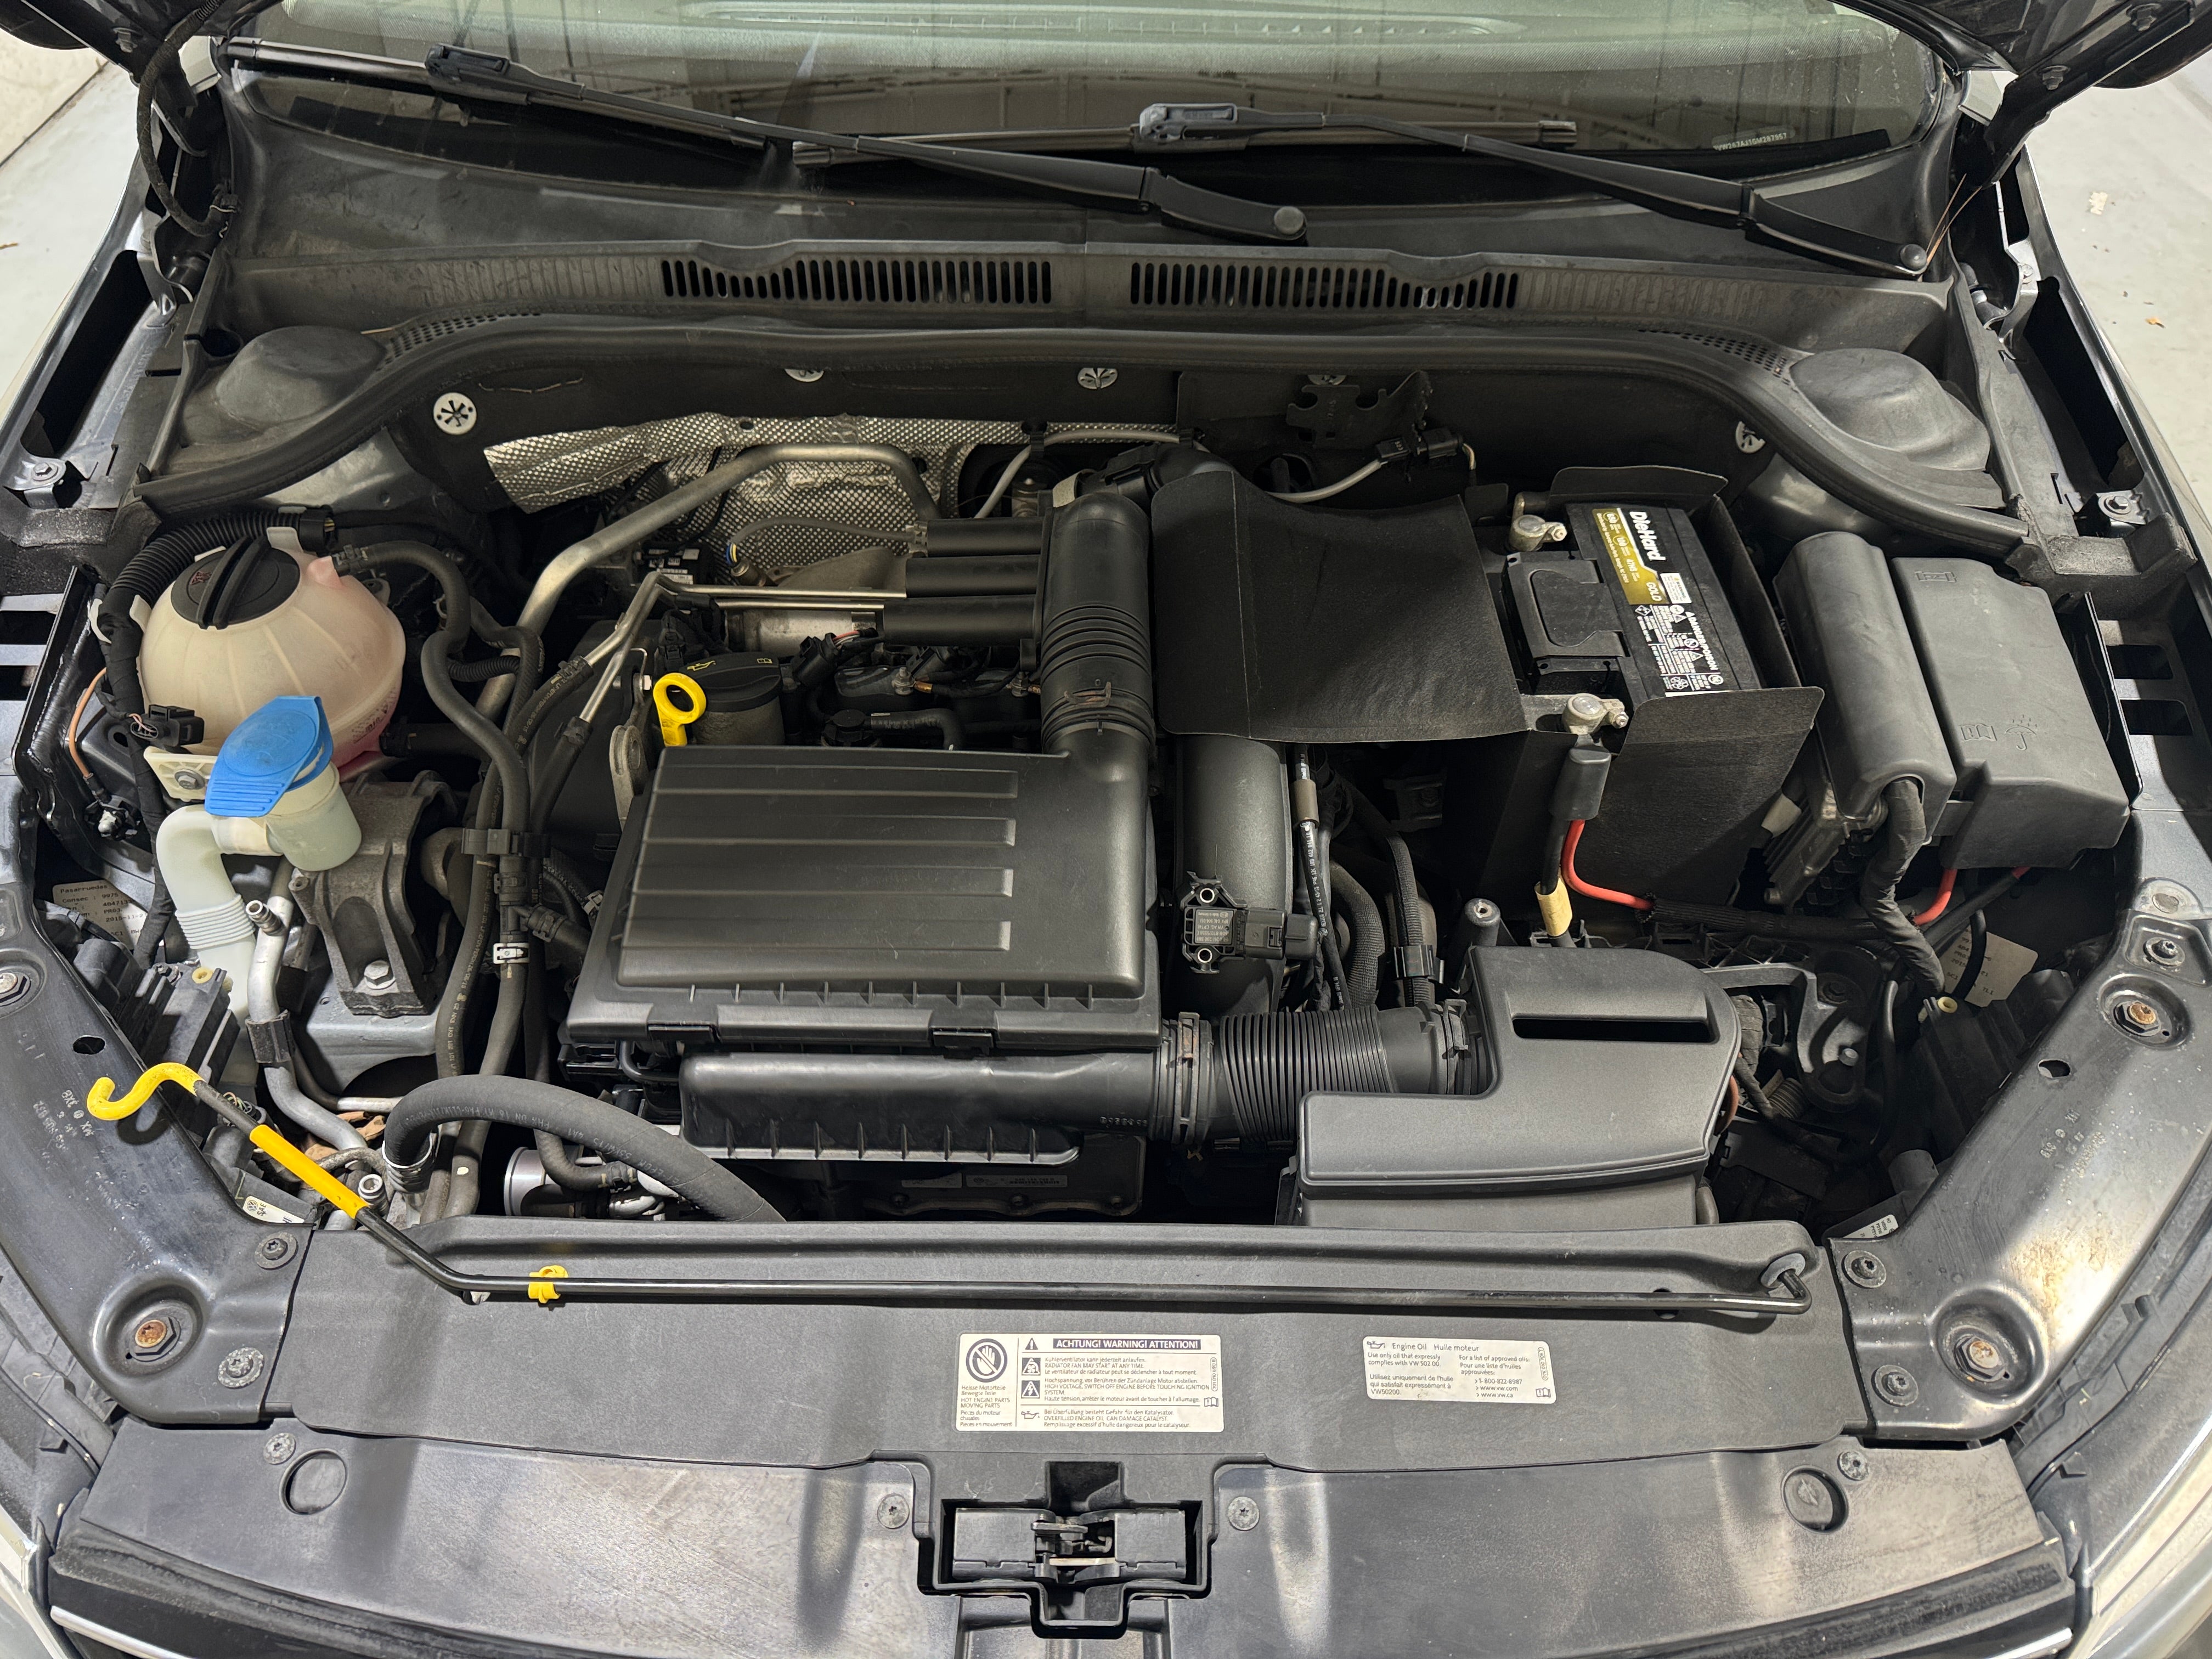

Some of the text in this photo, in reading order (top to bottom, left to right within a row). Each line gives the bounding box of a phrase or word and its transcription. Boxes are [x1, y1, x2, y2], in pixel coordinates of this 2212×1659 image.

[1629, 511, 1667, 562] DieHard
[1645, 582, 1662, 602] GOLD
[1688, 616, 1719, 670] DANGER/POISON
[60, 885, 108, 893] Pasarruedas
[257, 1202, 267, 1216] SAE
[1056, 1339, 1198, 1349] ACHTUNG! WARNING! ATTENTION!
